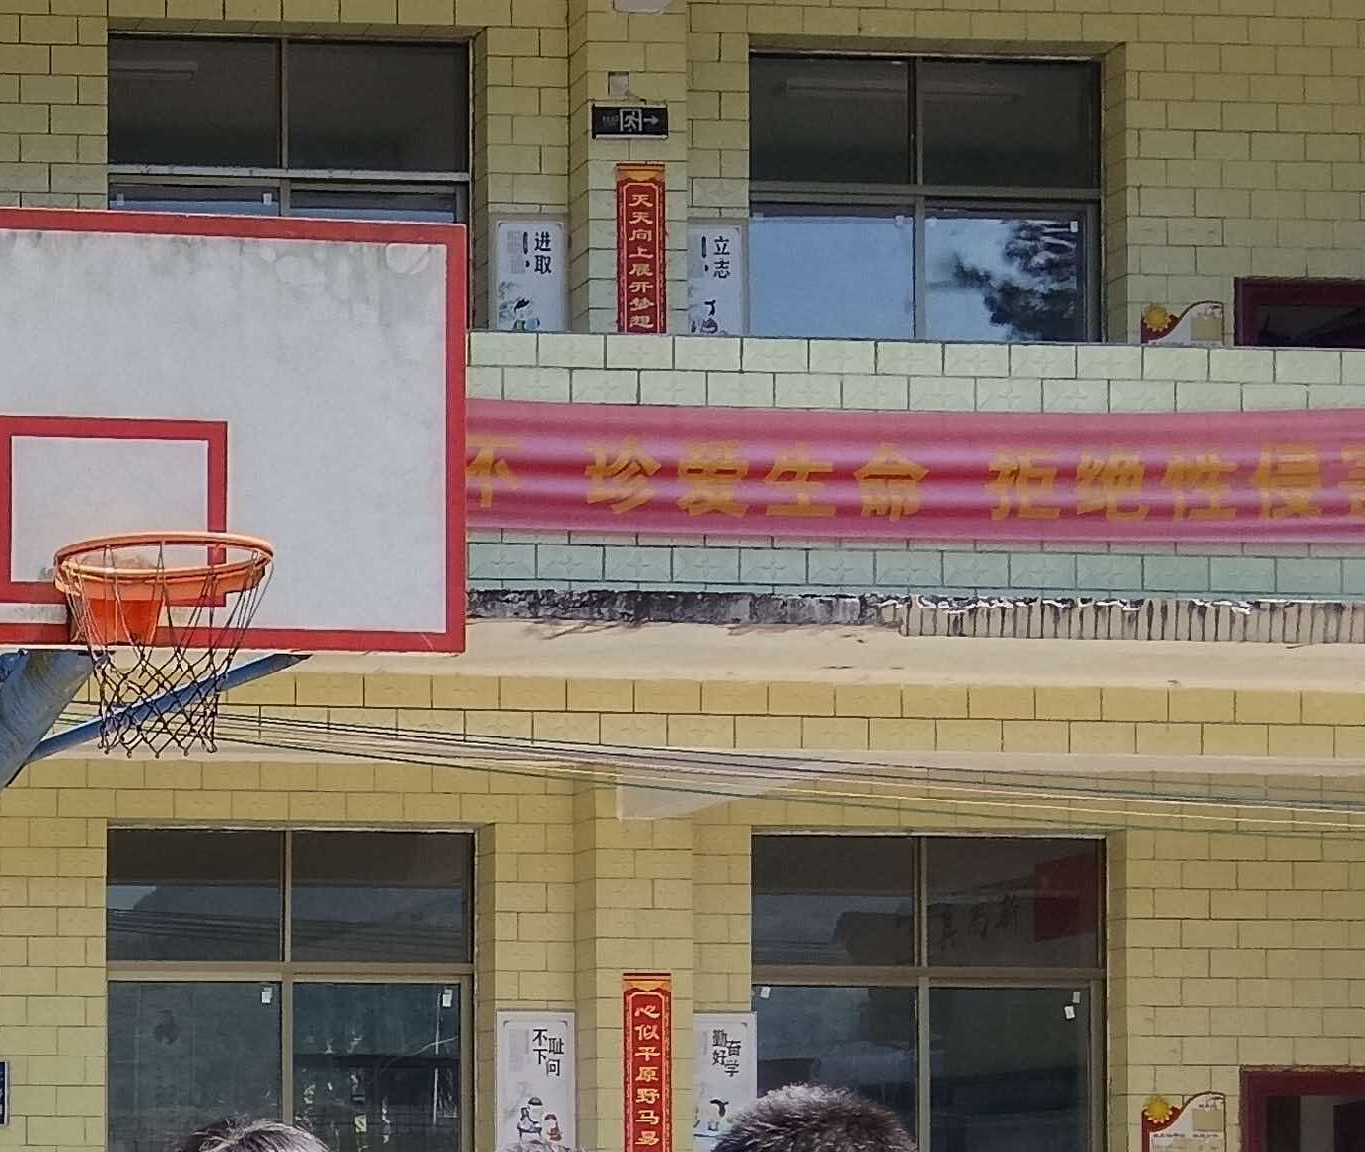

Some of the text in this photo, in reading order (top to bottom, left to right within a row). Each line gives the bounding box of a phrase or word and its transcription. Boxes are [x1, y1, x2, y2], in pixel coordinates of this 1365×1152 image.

[533, 231, 552, 275] 进取
[628, 194, 654, 328] 天天向上展开梦想
[713, 236, 731, 279] 立志
[582, 434, 930, 521] 珍爱生命
